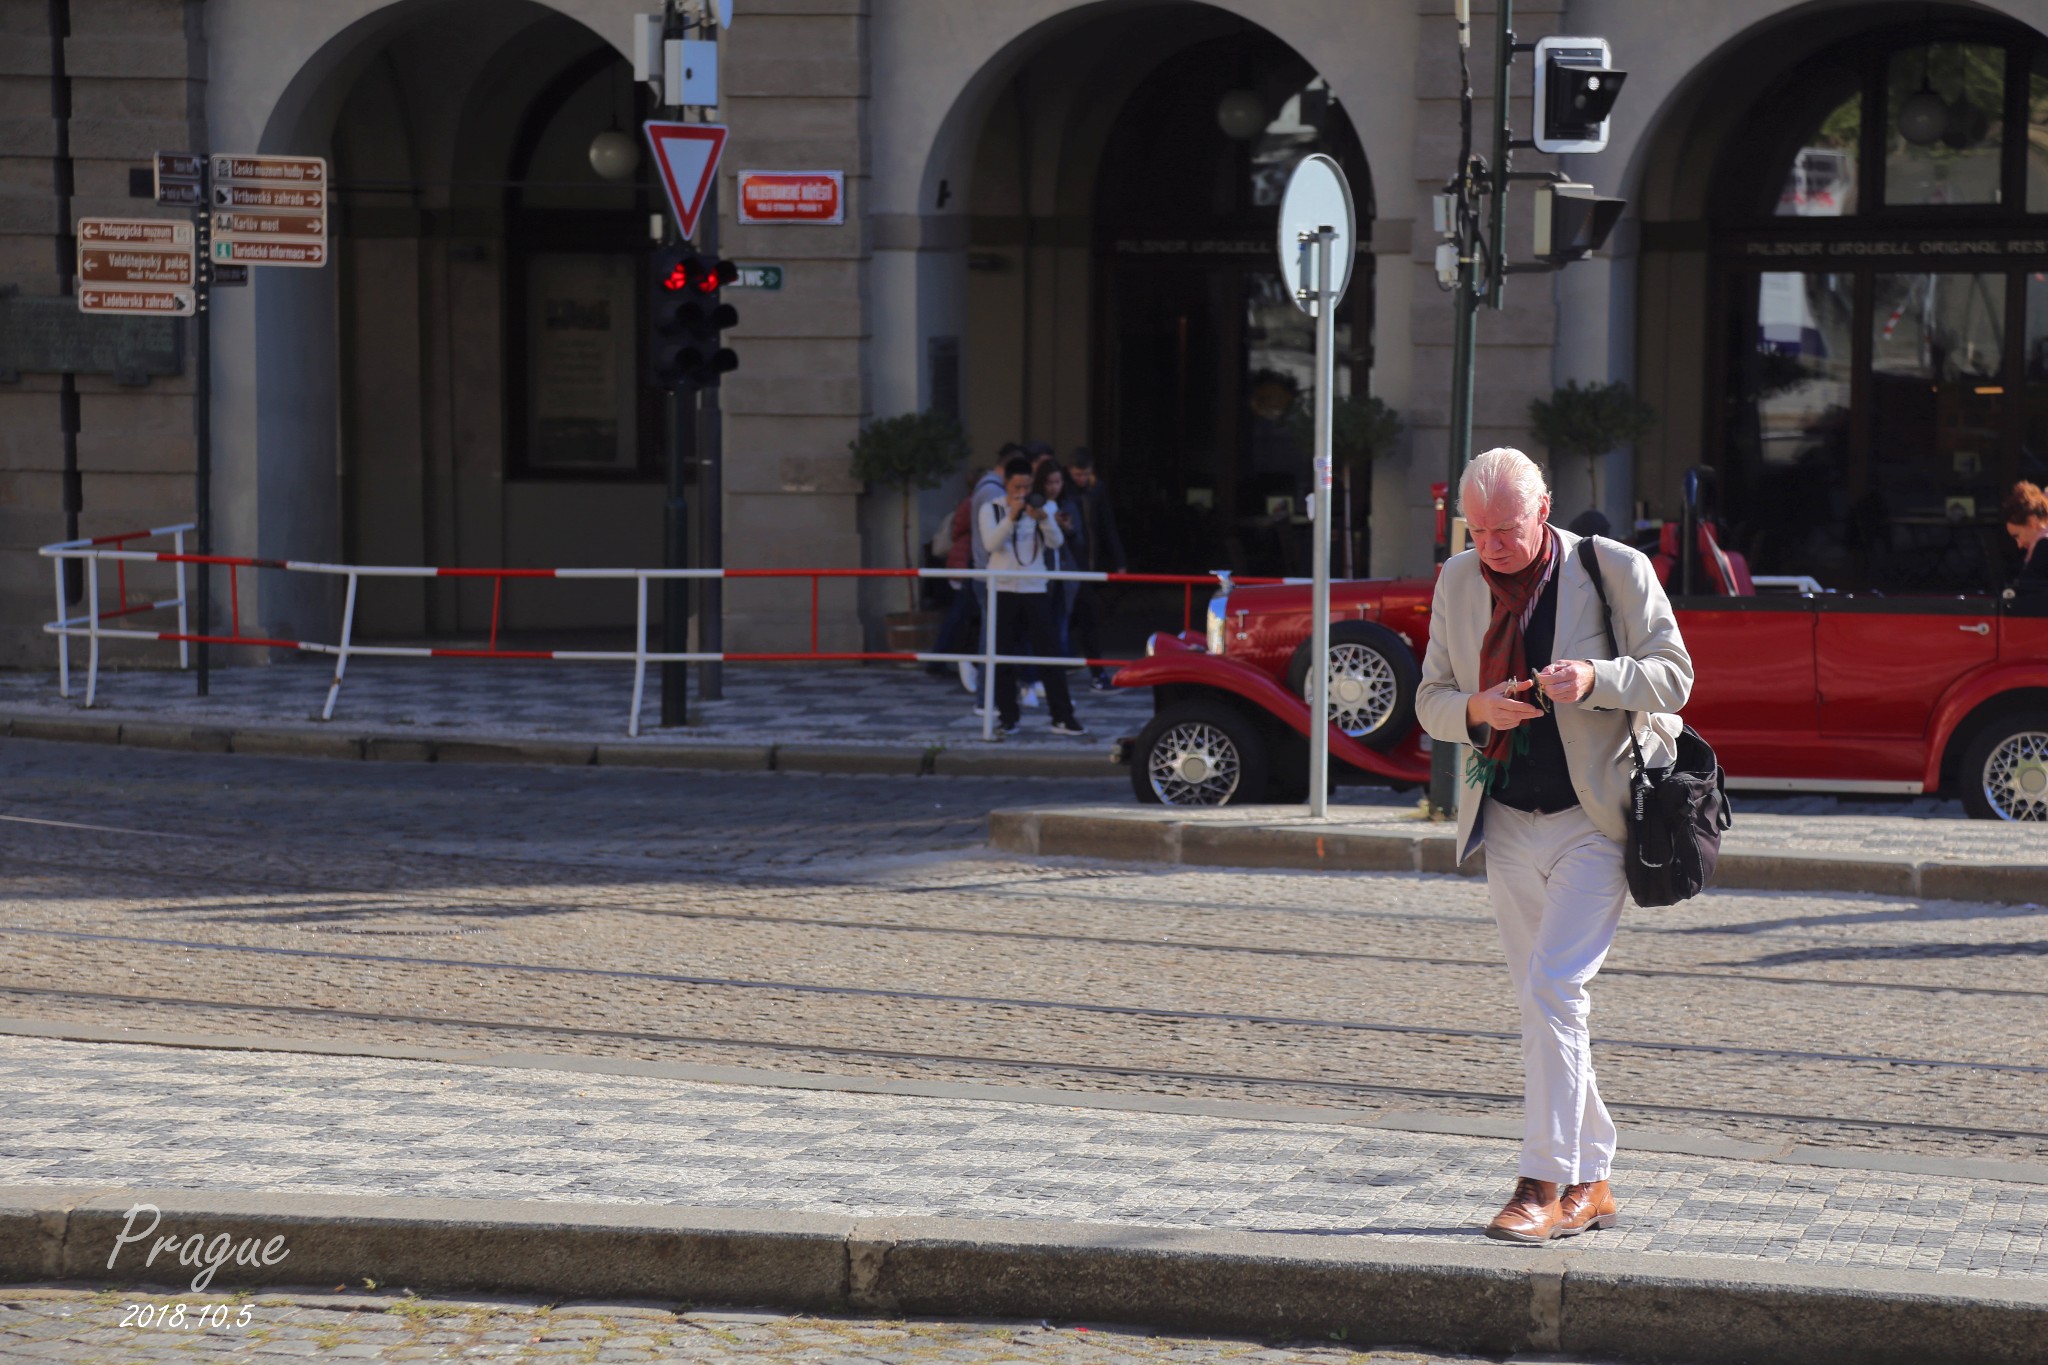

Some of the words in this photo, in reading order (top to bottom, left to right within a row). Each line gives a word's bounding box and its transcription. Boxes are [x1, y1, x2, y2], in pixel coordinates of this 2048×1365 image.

[254, 164, 283, 177] muzeum
[284, 164, 304, 181] hudby
[274, 191, 304, 206] zahrada
[143, 226, 171, 238] muzeum
[269, 245, 305, 260] informace
[1746, 242, 1823, 256] PILSNER
[1829, 242, 1913, 255] URQUELL
[744, 270, 765, 286] WC
[145, 293, 174, 309] zahrada
